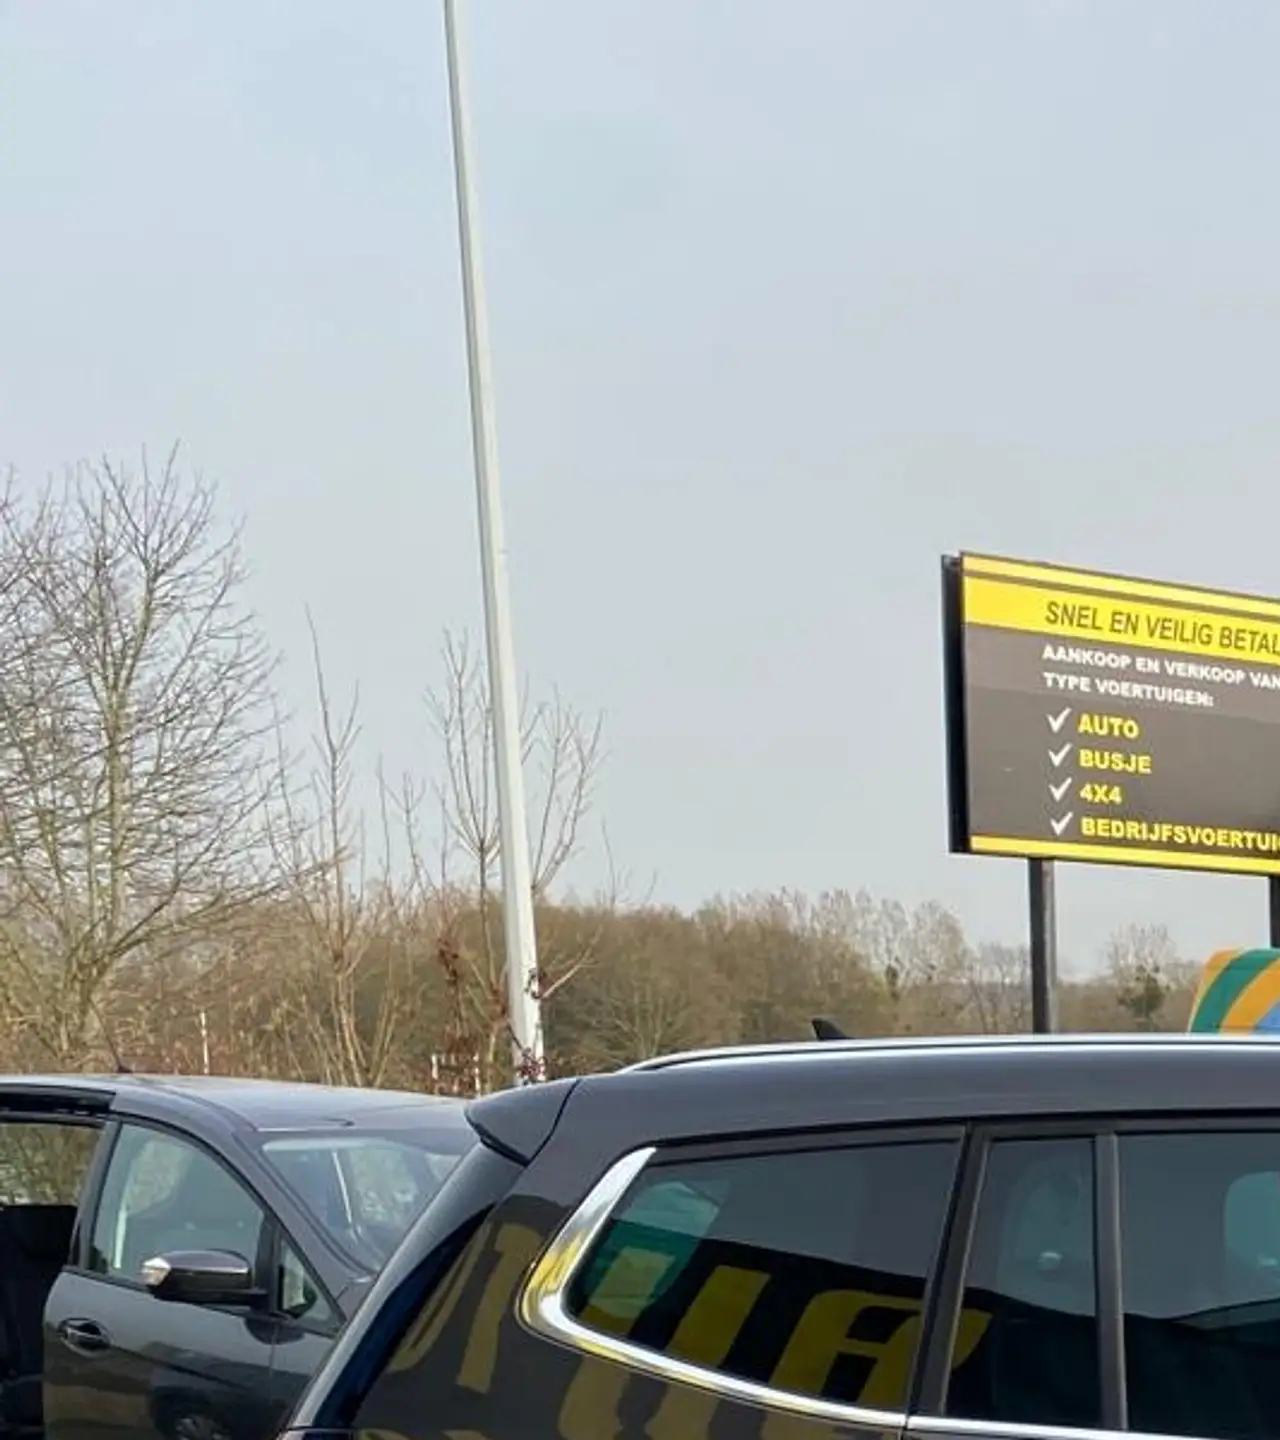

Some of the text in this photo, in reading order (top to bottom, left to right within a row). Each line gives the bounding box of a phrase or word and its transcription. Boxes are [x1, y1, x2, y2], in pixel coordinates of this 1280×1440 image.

[1045, 600, 1103, 631] SNEL
[1109, 610, 1139, 637] EN
[1146, 615, 1213, 646] VEILIG
[1042, 644, 1131, 670] AANKOOP
[1135, 656, 1160, 674] EN
[1163, 660, 1246, 685] VERKOOP
[1042, 672, 1215, 707] TYPE VOERTUIGEN:
[1077, 713, 1140, 740] AUTO
[1079, 748, 1152, 775] BUSJE
[1079, 782, 1123, 805] 4X4
